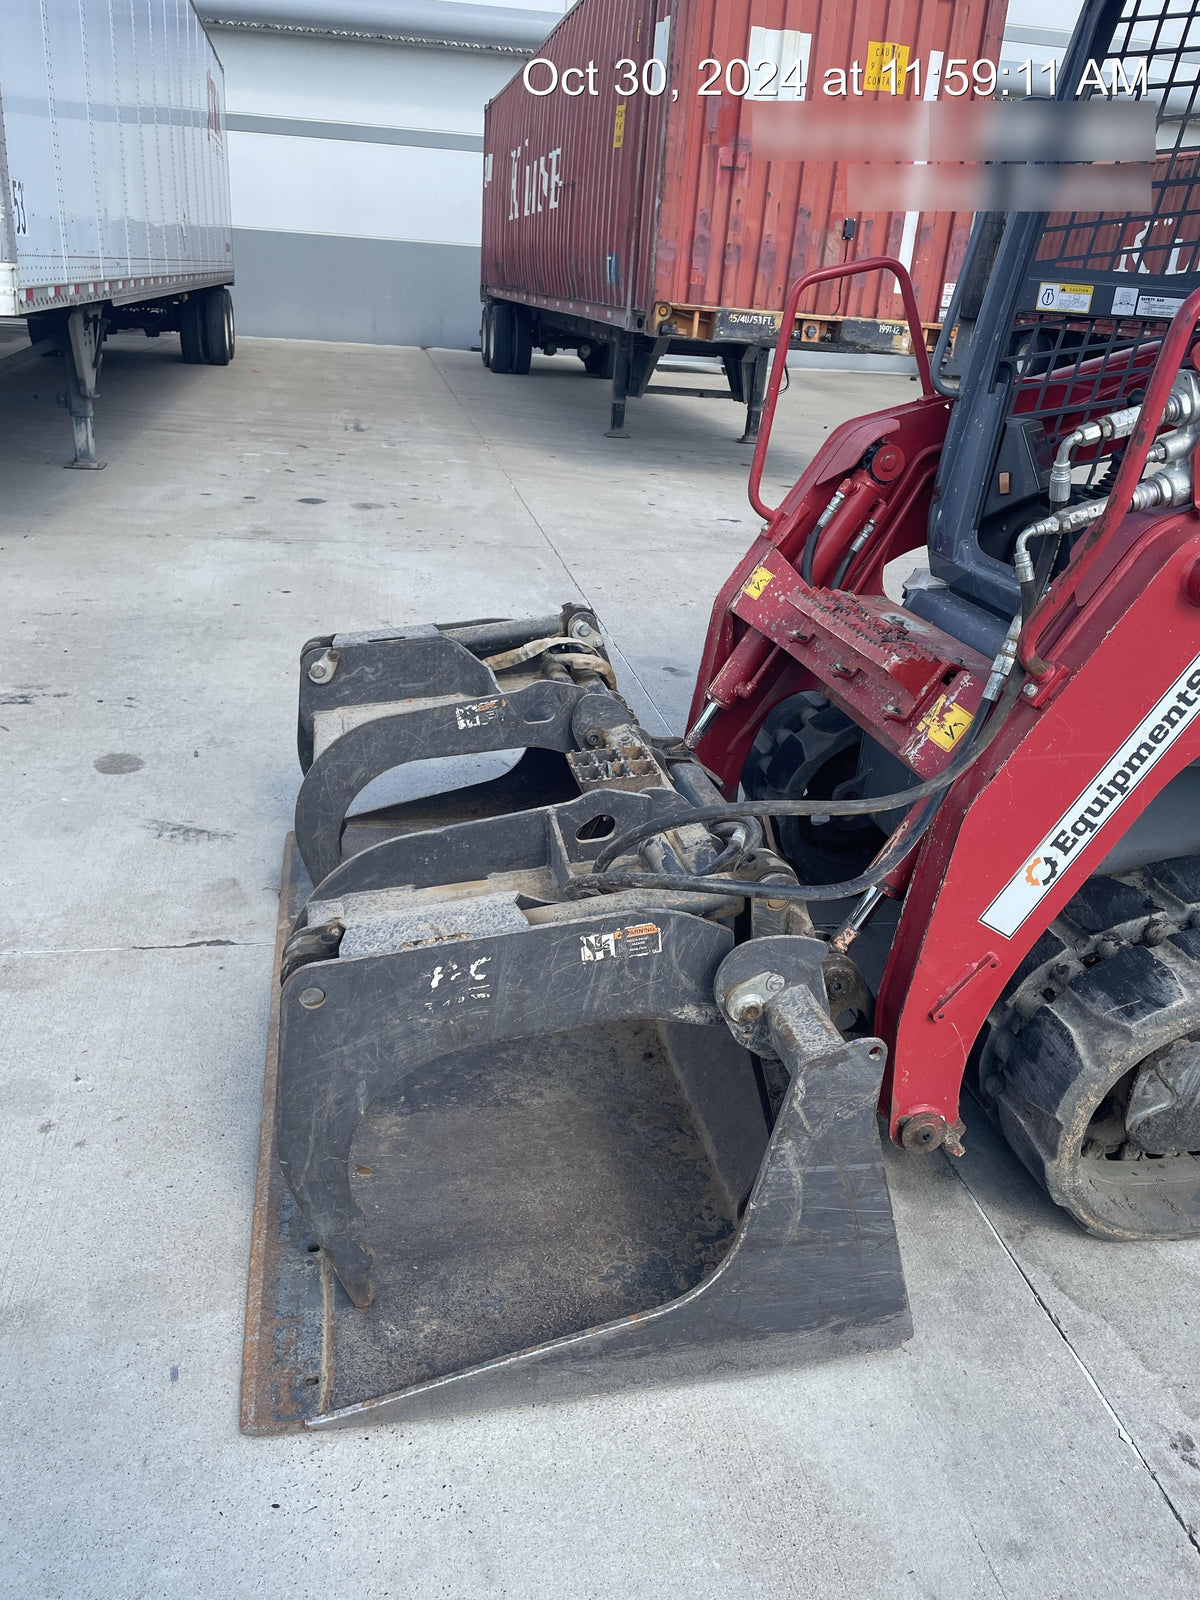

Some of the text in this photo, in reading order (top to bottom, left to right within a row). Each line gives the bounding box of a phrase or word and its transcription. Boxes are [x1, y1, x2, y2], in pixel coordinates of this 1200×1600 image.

[867, 75, 902, 89] CONTAR
[1050, 668, 1200, 856] Equipments
[628, 925, 656, 935] ARNING
